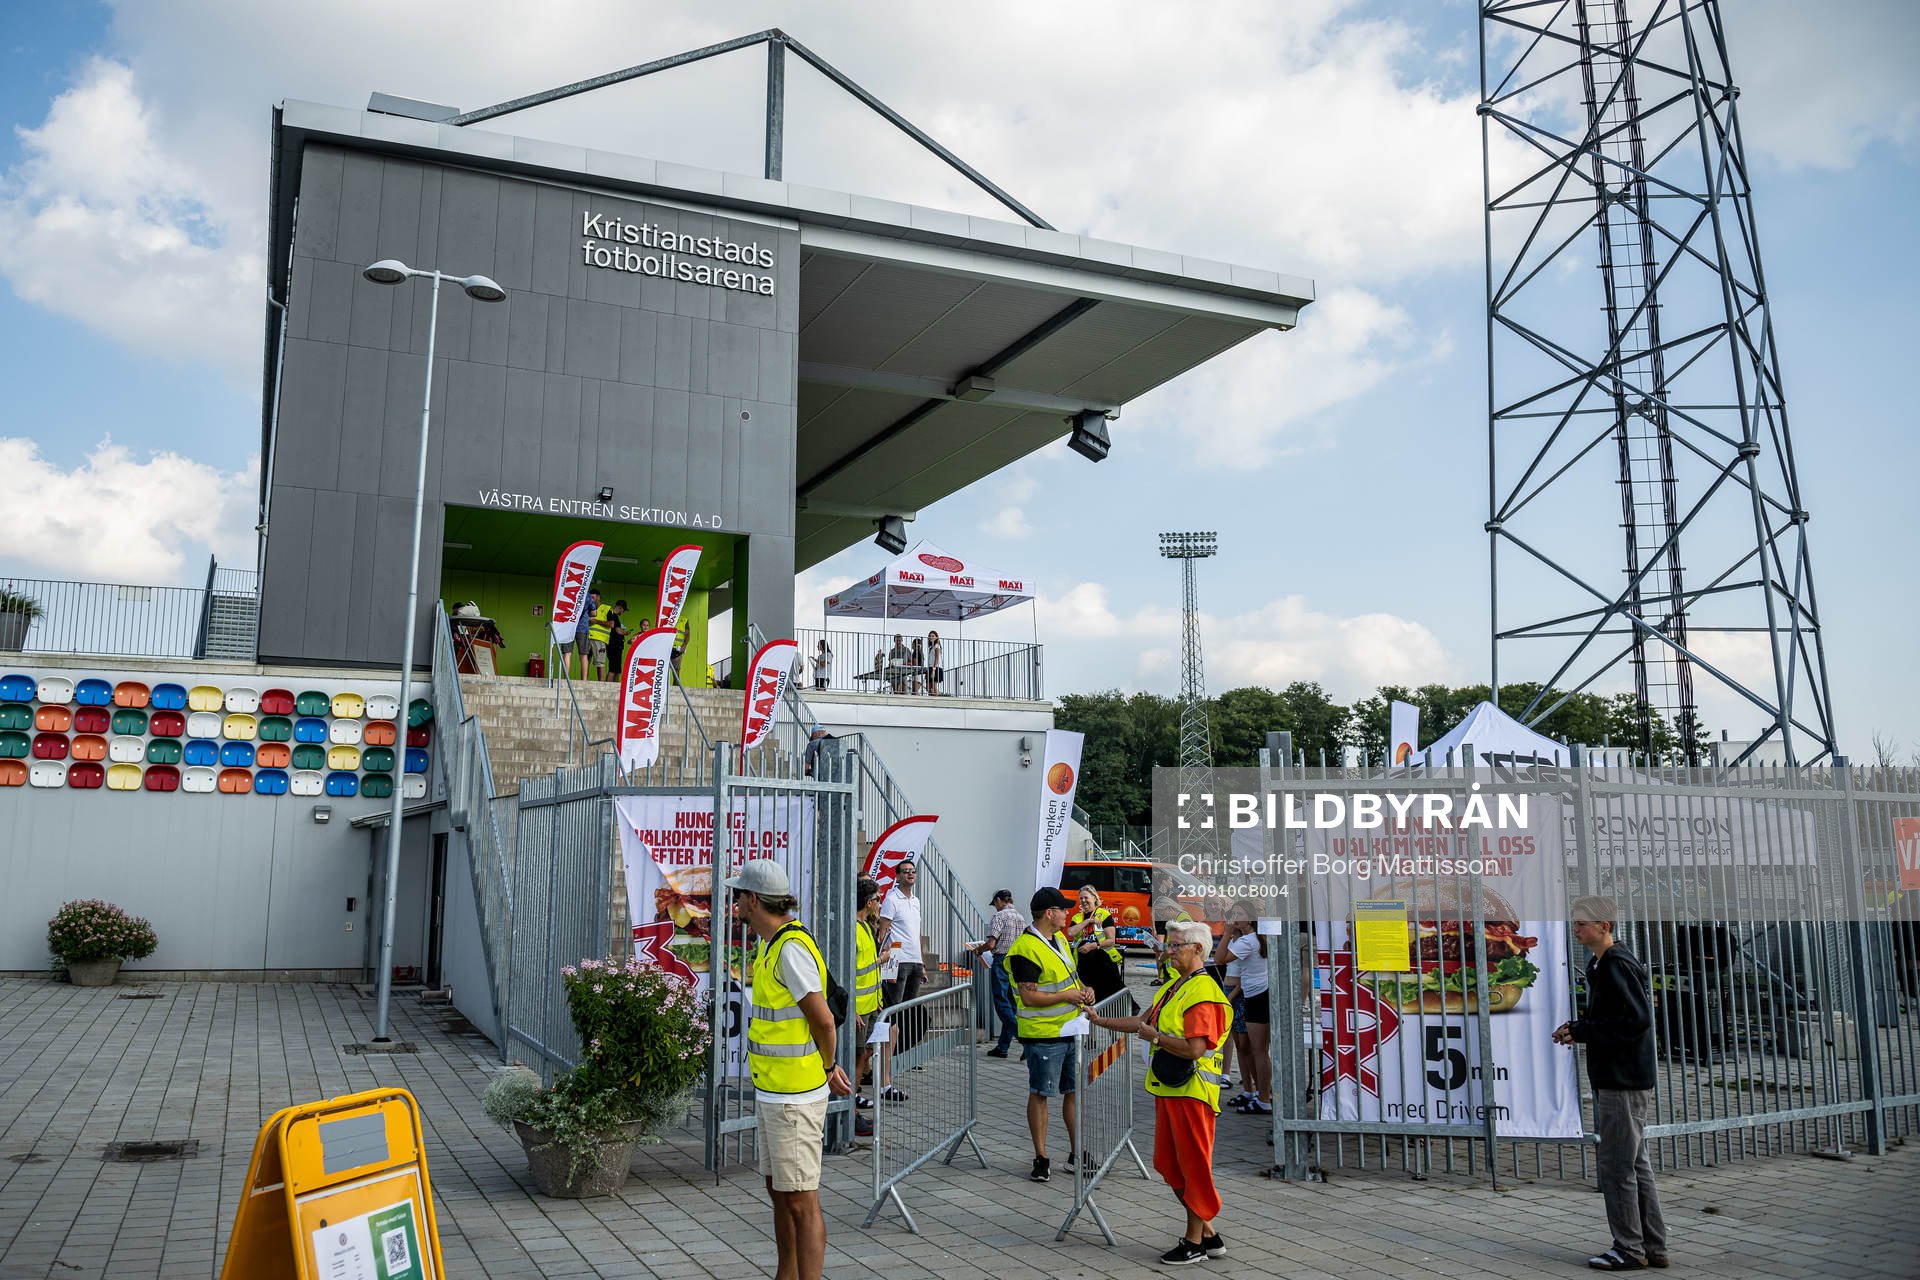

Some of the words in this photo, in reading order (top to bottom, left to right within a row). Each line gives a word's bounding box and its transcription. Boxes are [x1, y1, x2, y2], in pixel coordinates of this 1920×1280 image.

[583, 211, 774, 268] Kristianstads
[583, 241, 775, 296] fotbollsarena
[479, 489, 543, 511] VÄSTRA
[550, 498, 614, 518] ENTRÉN
[619, 505, 687, 526] SEKTION
[554, 561, 587, 623] MAXI
[660, 567, 687, 627] MAXI
[899, 570, 925, 581] MAXI
[949, 575, 975, 586] MAXI
[998, 580, 1022, 590] MAXI
[625, 657, 657, 739] MAXI
[650, 659, 665, 724] STORMARKNAD
[746, 667, 779, 744] MAXI
[635, 829, 715, 847] VÄLKOMME
[651, 848, 694, 865] EFTER
[1041, 799, 1057, 869] Sparbanken
[1498, 836, 1536, 855] OSS
[1426, 1026, 1467, 1090] 5
